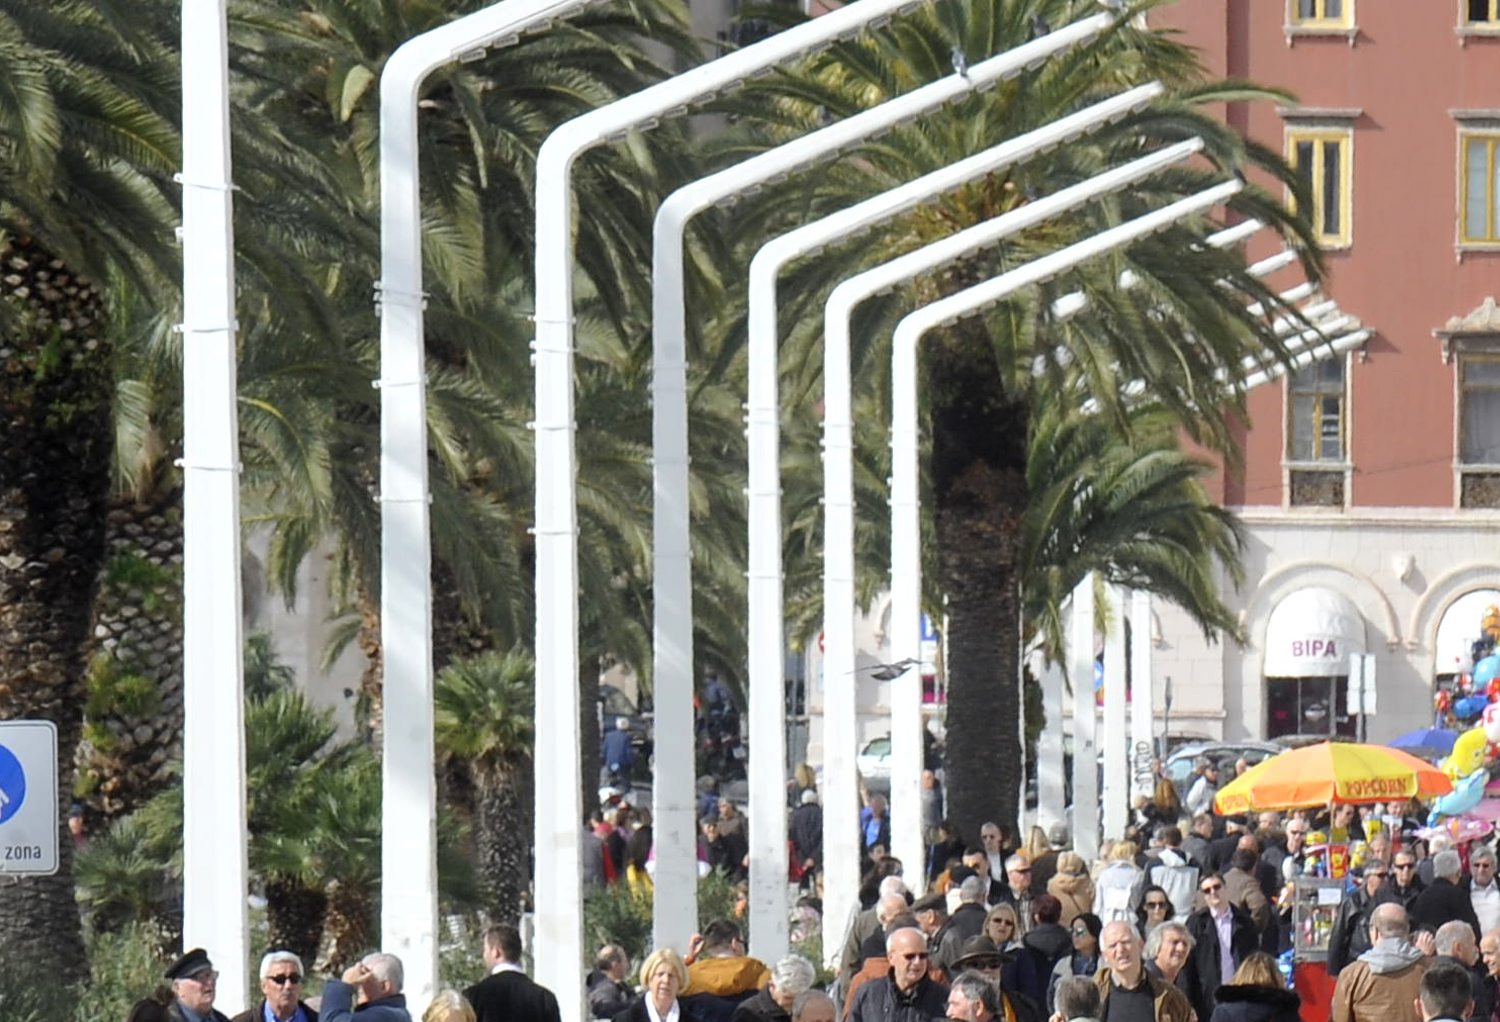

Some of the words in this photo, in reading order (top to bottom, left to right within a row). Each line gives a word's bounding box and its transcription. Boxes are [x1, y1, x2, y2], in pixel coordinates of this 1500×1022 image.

[1292, 639, 1336, 657] BIPA
[1344, 777, 1406, 796] POPCORN
[5, 844, 41, 860] zona
